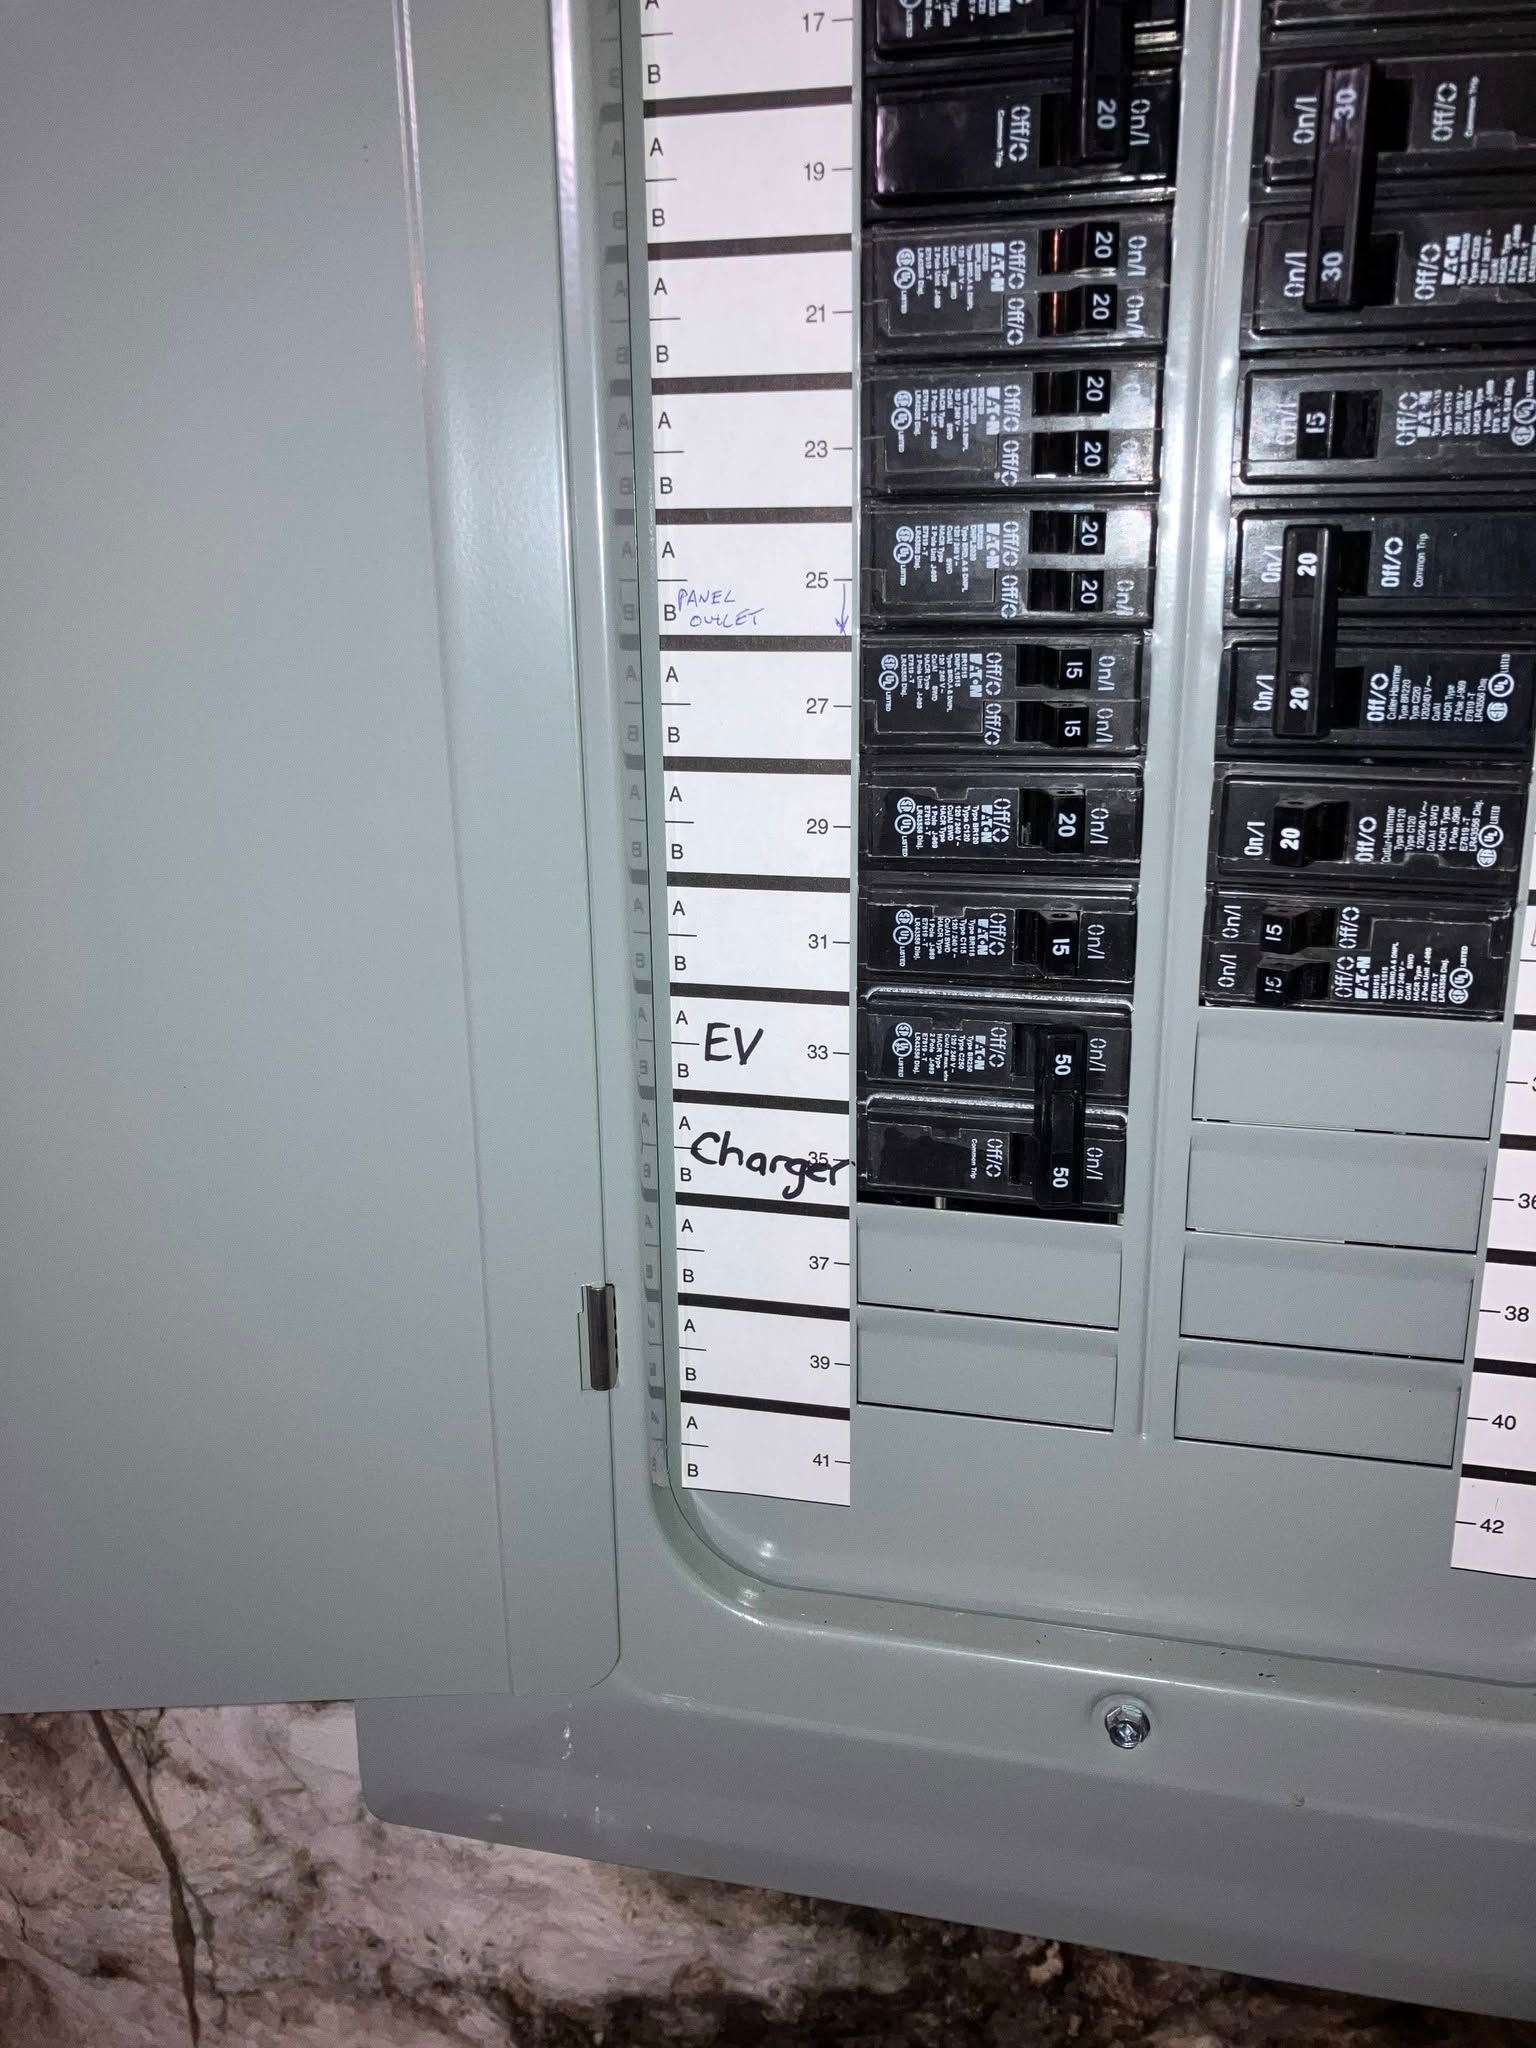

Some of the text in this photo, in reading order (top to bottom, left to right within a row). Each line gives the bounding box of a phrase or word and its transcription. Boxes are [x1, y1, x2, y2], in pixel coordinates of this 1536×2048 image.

[802, 13, 825, 32] 17
[648, 64, 661, 83] B
[1335, 88, 1357, 119] 30
[1097, 100, 1116, 129] 20
[650, 138, 663, 156] A
[803, 162, 825, 181] 19
[652, 209, 665, 227] B
[1095, 232, 1112, 258] 20
[1322, 252, 1343, 281] 30
[654, 278, 668, 295] A
[806, 306, 826, 322] 21
[1093, 293, 1111, 320] 20
[656, 345, 669, 362] B
[1086, 376, 1104, 401] 20
[658, 412, 671, 429] A
[1306, 412, 1326, 434] 15
[805, 441, 828, 458] 23
[1084, 442, 1101, 467] 20
[660, 477, 673, 494] B
[1082, 522, 1098, 546] 20
[662, 542, 675, 558] A
[1298, 553, 1317, 576] 20
[1413, 533, 1429, 587] Common Trip
[805, 572, 828, 588] 25
[677, 588, 736, 611] PANEL
[1081, 580, 1097, 604] 20
[664, 605, 677, 621] B
[666, 667, 679, 683] A
[1066, 661, 1083, 678] 15
[806, 698, 829, 714] 27
[1290, 688, 1309, 711] 20
[668, 727, 680, 742] B
[1064, 720, 1081, 737] 15
[669, 786, 682, 802] A
[1430, 805, 1439, 826] SWD
[806, 819, 829, 834] 29
[1058, 813, 1076, 837] 20
[1405, 816, 1416, 851] Type C120
[1438, 807, 1450, 851] HACR Type
[1280, 828, 1300, 850] 20
[1394, 835, 1404, 850] Type
[672, 844, 683, 859] B
[672, 900, 685, 916] A
[1265, 924, 1282, 941] 15
[808, 934, 827, 949] 31
[1052, 938, 1070, 956] 15
[674, 956, 686, 970] B
[1265, 976, 1282, 994] 15
[676, 1010, 688, 1025] A
[705, 1023, 764, 1065] EV
[807, 1045, 828, 1060] 33
[678, 1064, 689, 1077] B
[1055, 1054, 1072, 1076] 50
[679, 1116, 691, 1130] A
[690, 1131, 855, 1199] Charger
[681, 1168, 692, 1182] B
[1053, 1167, 1069, 1188] 50
[681, 1219, 693, 1233] A
[809, 1256, 829, 1270] 37
[683, 1269, 694, 1282] B
[1505, 1306, 1529, 1322] 38
[684, 1319, 695, 1333] A
[810, 1356, 830, 1369] 39
[685, 1368, 697, 1381] B
[686, 1416, 698, 1429] A
[1492, 1415, 1516, 1429] 40
[813, 1454, 829, 1467] 41
[688, 1464, 698, 1477] B
[1480, 1519, 1504, 1534] 42
